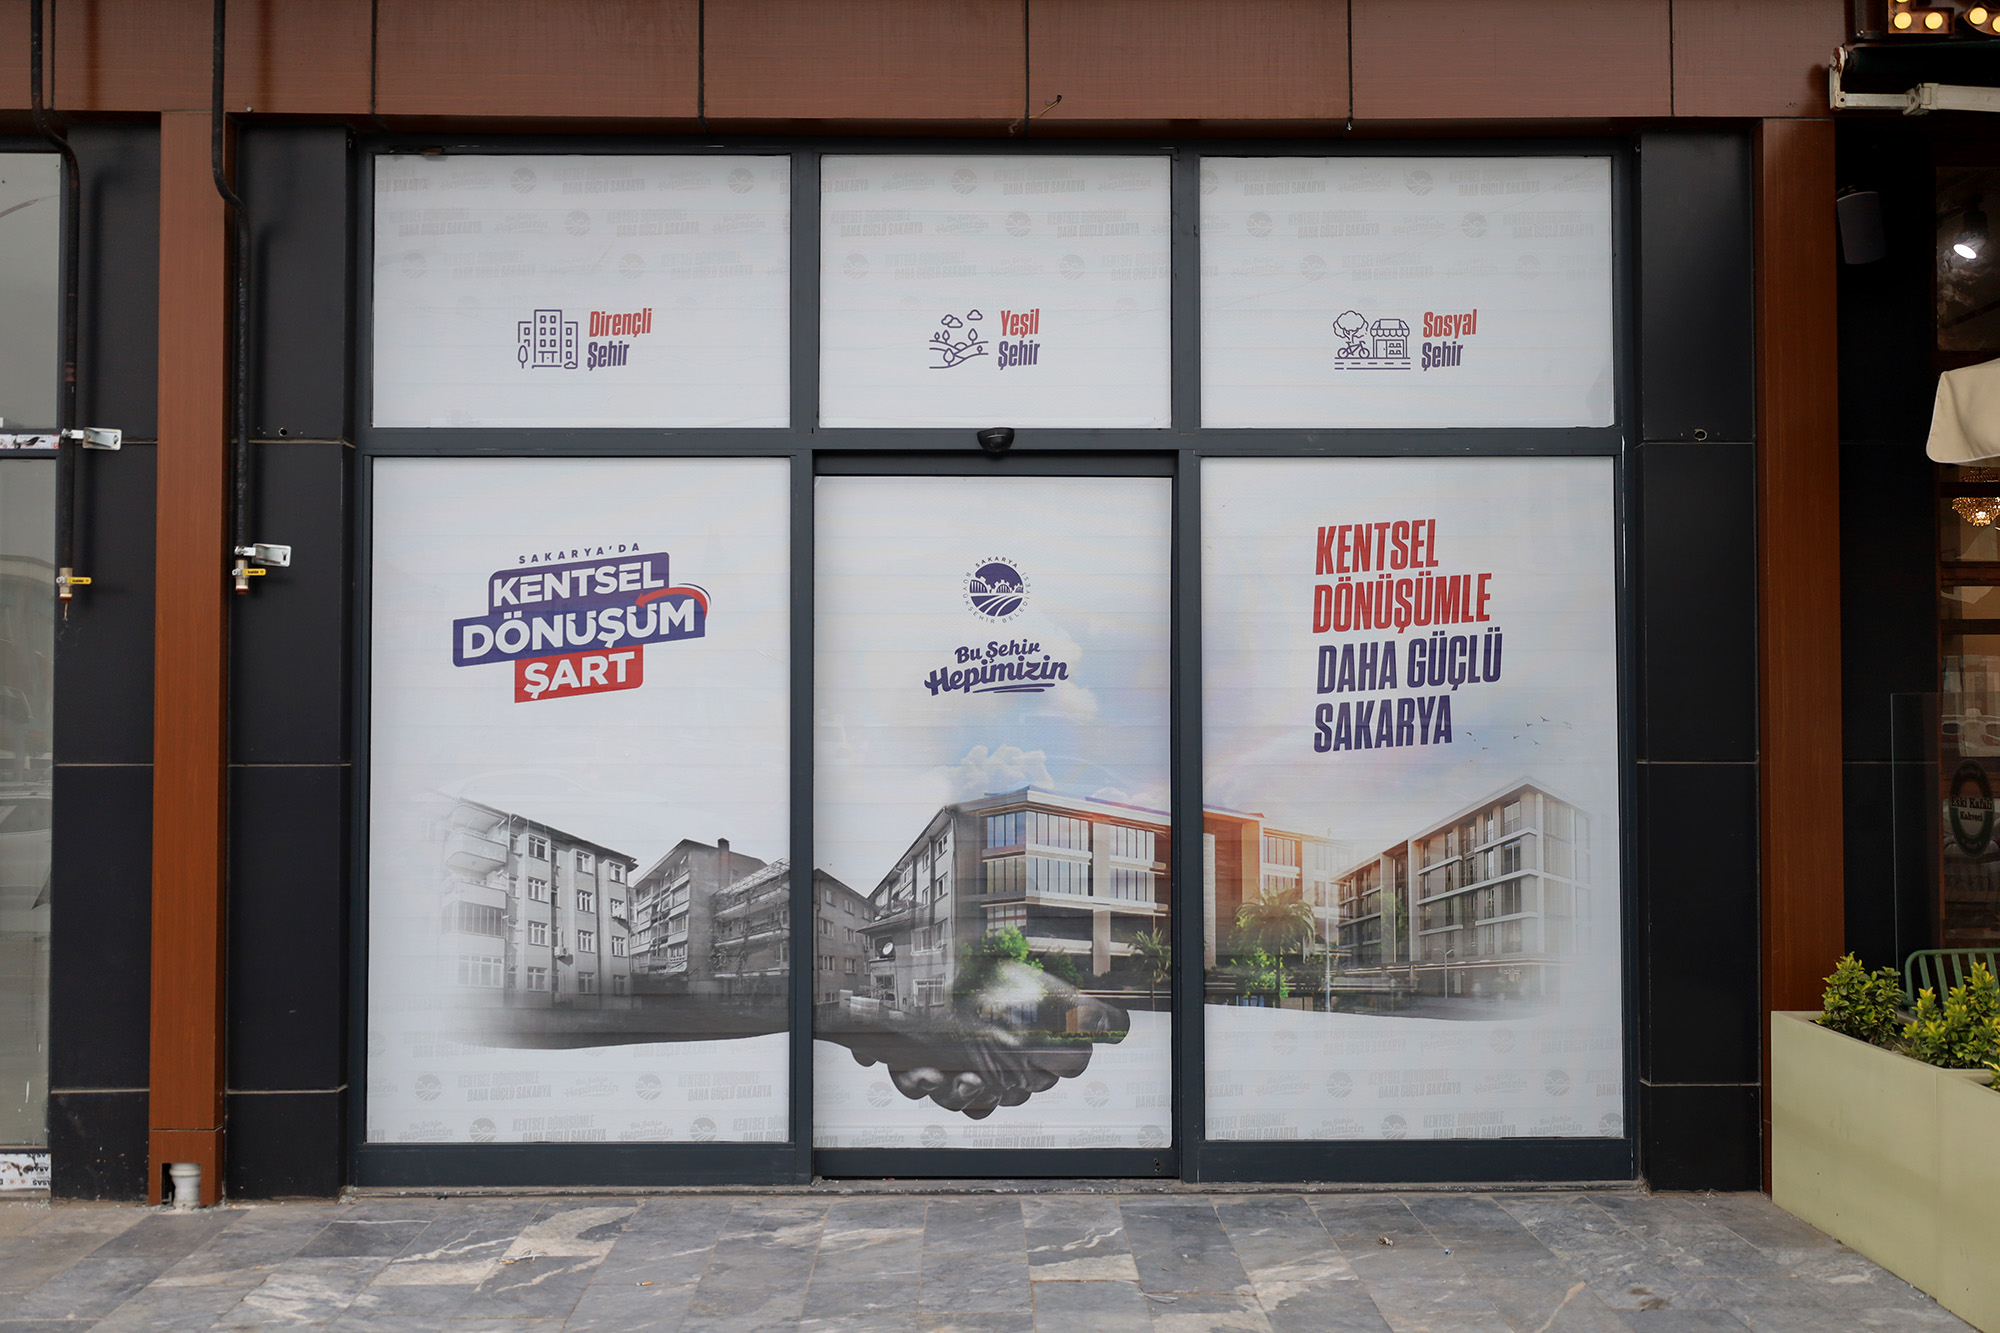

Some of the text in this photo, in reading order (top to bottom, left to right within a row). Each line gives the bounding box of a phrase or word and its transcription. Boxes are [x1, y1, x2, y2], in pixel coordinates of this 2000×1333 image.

[589, 307, 652, 337] Dirençli
[1000, 308, 1040, 339] Yeşil
[1423, 309, 1477, 339] Sosyal
[587, 342, 629, 371] Şehir
[998, 341, 1040, 369] Şehir
[1421, 341, 1463, 371] Şehir
[519, 543, 640, 564] SAKARYA'DA
[975, 556, 1018, 568] SAKARYA
[1315, 518, 1439, 575] KENTSEL
[493, 561, 664, 607] KENTSEL
[1312, 570, 1492, 634] DÖNÜŞÜMLE
[462, 599, 695, 659] DÖNÜŞÜM
[954, 638, 1041, 664] Bu Şehir
[1316, 626, 1503, 694] DAHA GÜÇLÜ
[523, 651, 635, 699] ŞART
[924, 655, 1069, 696] Hepimizin
[1313, 694, 1453, 753] SAKARYA
